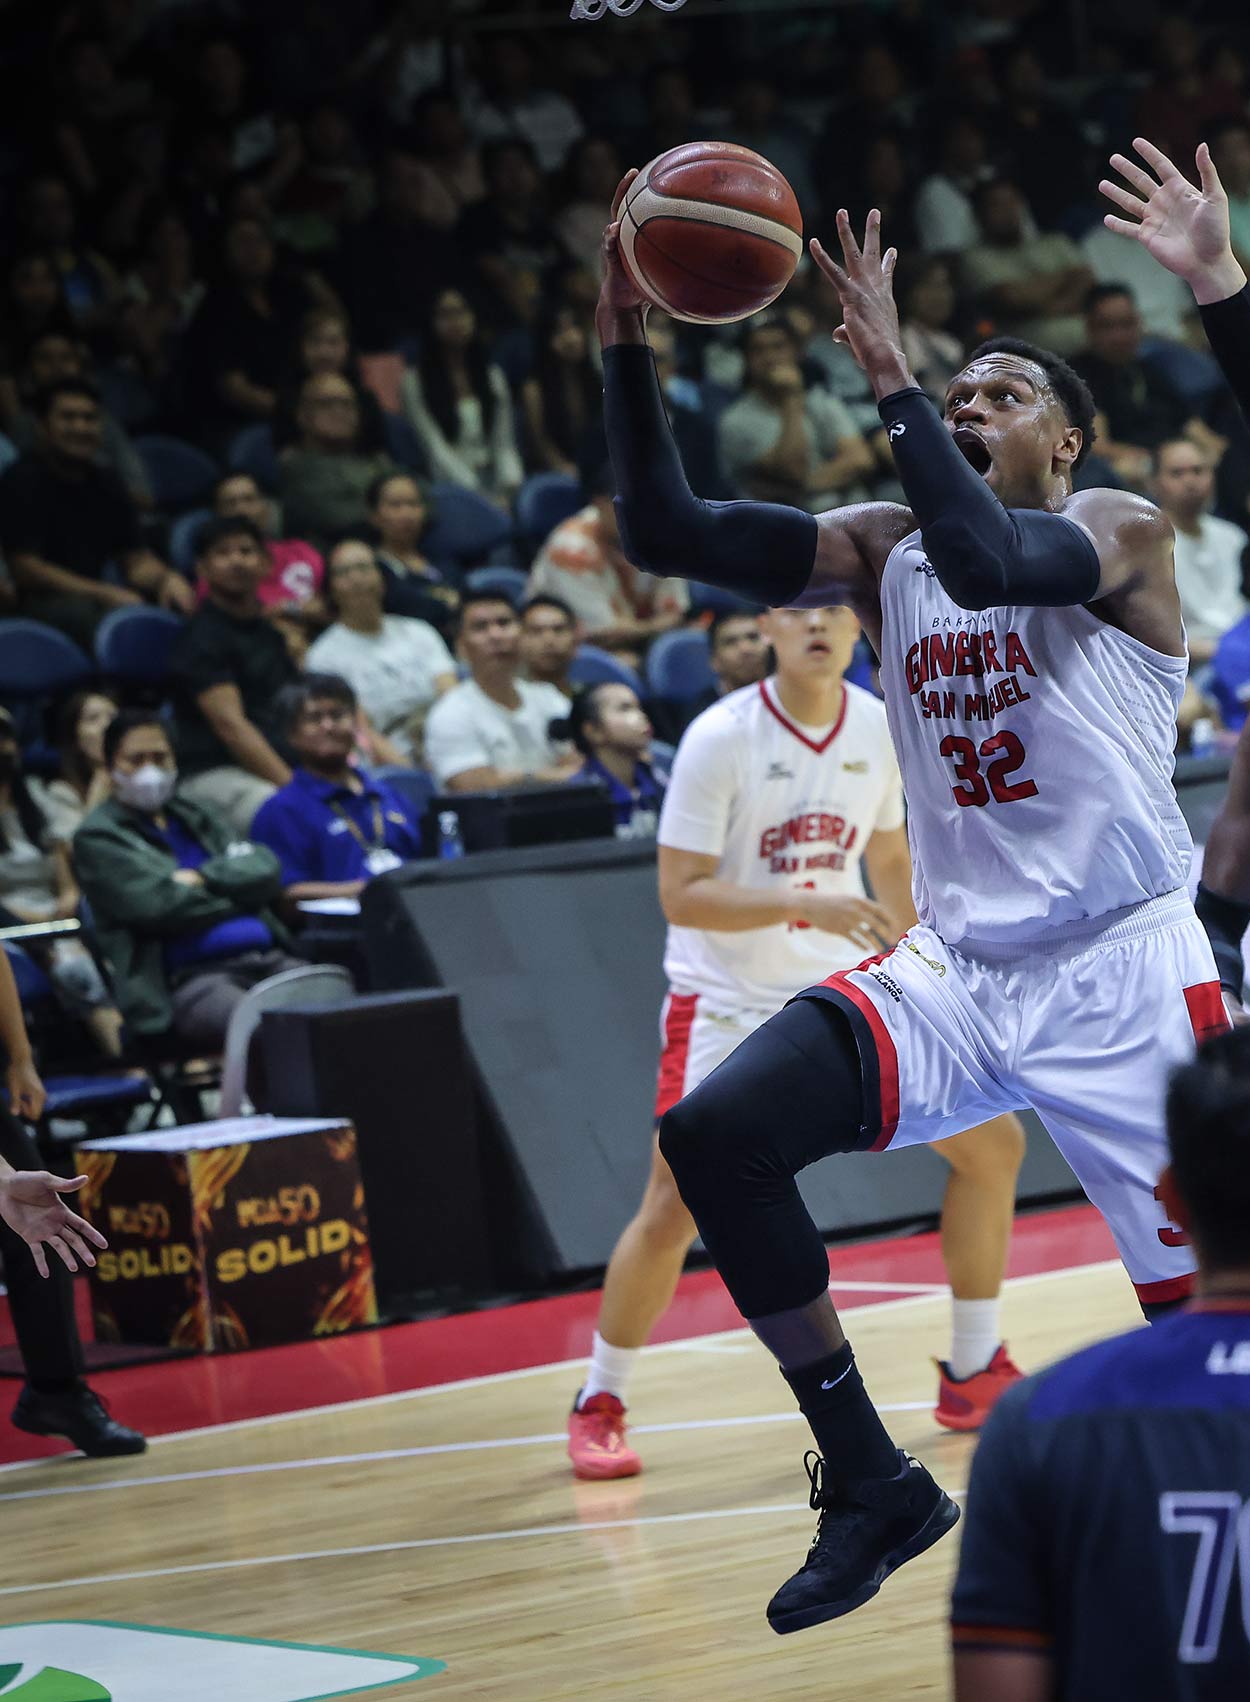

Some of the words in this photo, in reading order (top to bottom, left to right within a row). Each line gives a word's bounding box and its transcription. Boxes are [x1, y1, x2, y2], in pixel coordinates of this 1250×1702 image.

[905, 630, 1038, 695] GINEBRA
[920, 689, 956, 719] SAN
[939, 730, 1039, 807] 32
[868, 971, 901, 1003] ALANCE
[97, 1243, 193, 1282] SOLID
[215, 1218, 351, 1284] SOLID
